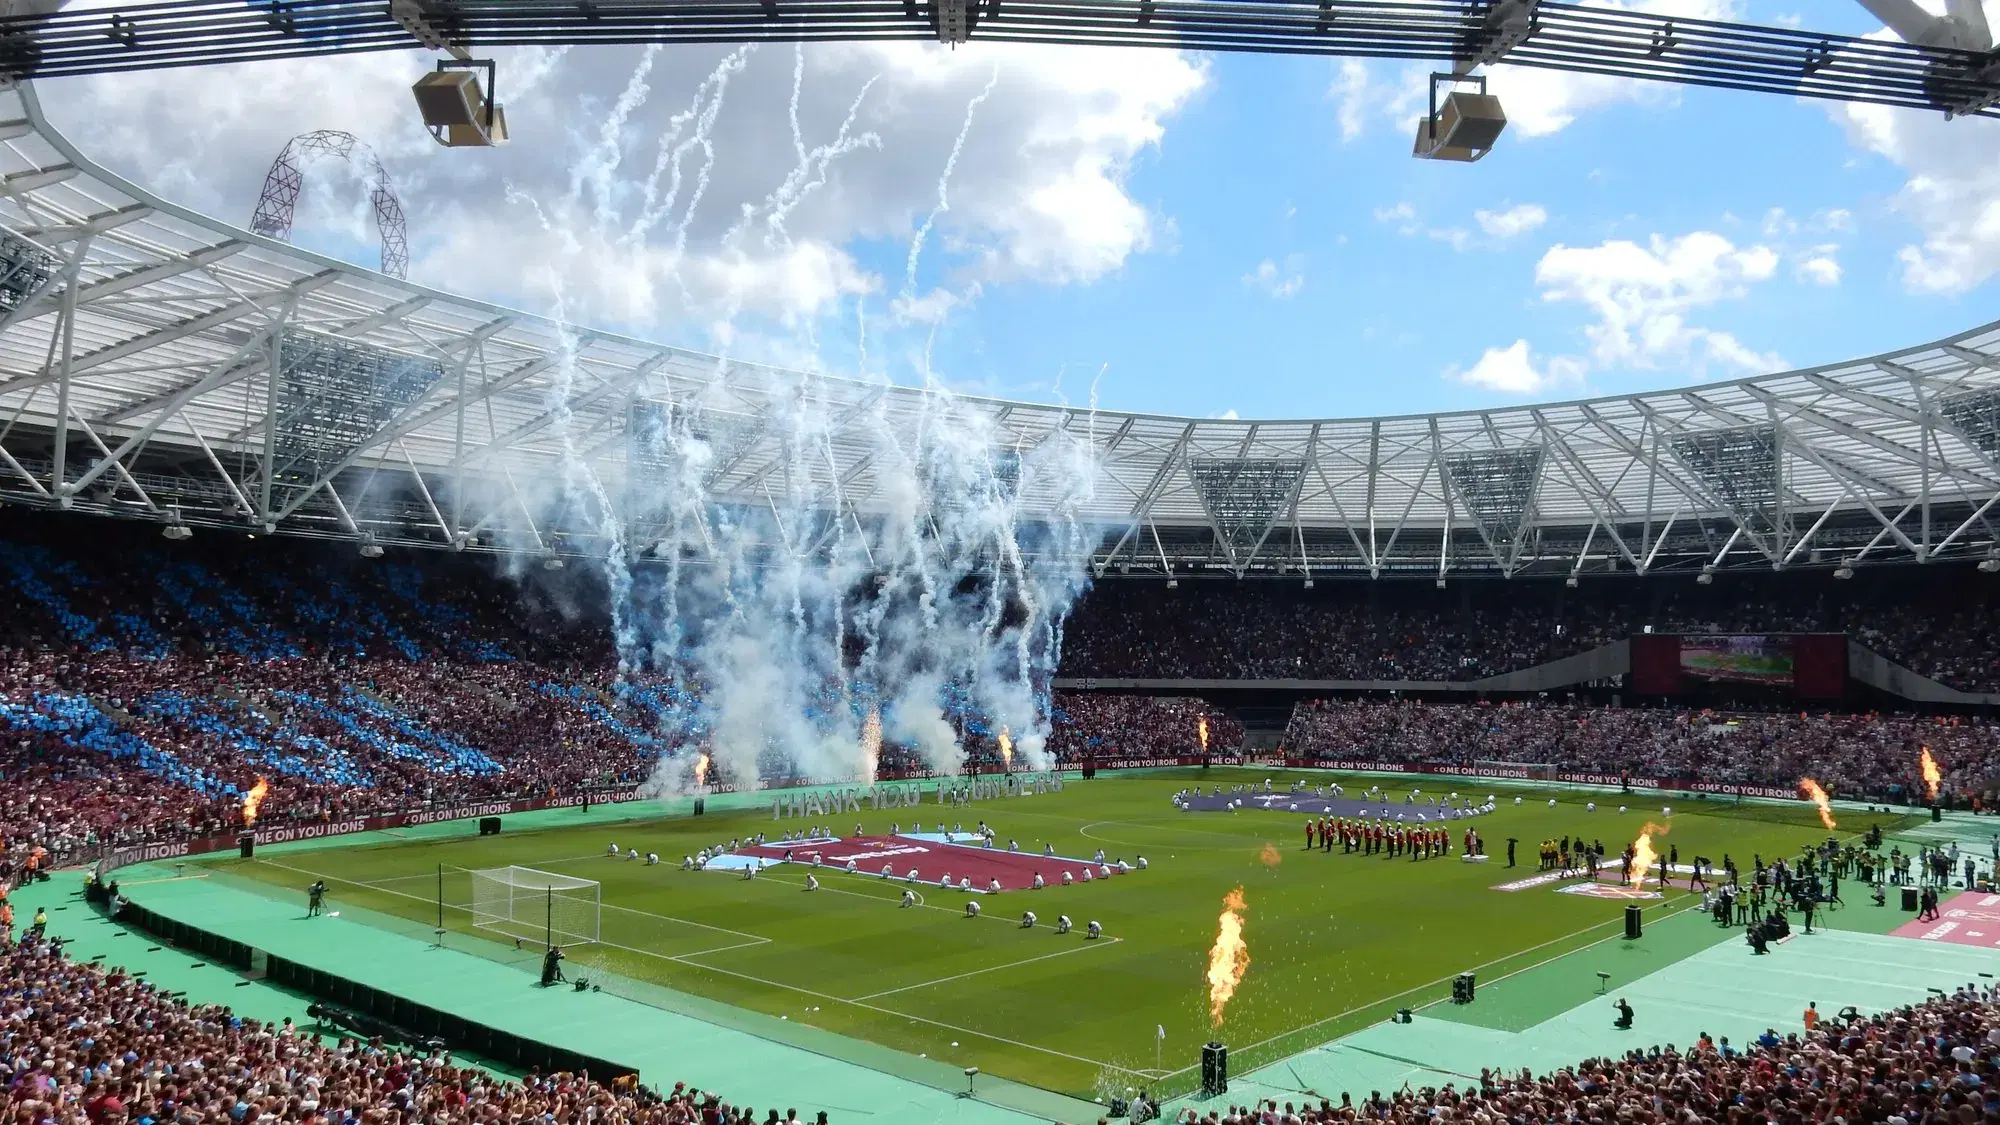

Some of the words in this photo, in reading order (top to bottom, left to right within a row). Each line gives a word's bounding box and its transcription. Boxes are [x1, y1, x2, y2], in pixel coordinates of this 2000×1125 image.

[1061, 762, 1084, 770] IRONS
[1157, 758, 1178, 766] IRONS
[1224, 757, 1238, 765] ON
[1340, 761, 1354, 769] ON
[1355, 762, 1375, 770] YOU
[1376, 763, 1404, 772] IRONS
[1461, 767, 1475, 775] ON
[1478, 768, 1497, 777] YOU
[1499, 769, 1528, 778] IRONS
[1587, 774, 1603, 783] ON
[1722, 784, 1738, 794] ON
[1740, 786, 1763, 796] YOU
[1764, 788, 1798, 799] IRONS
[593, 793, 614, 804] YOU
[771, 787, 860, 821] THANK
[867, 782, 921, 811] YOU
[436, 809, 453, 822] ON
[455, 806, 477, 819] YOU
[479, 803, 511, 815] IRONS
[235, 831, 273, 845] CME
[275, 828, 295, 842] ON
[297, 824, 324, 838] YOU
[327, 820, 365, 834] IRONS
[120, 849, 143, 865] YOU
[145, 843, 189, 860] IRONS
